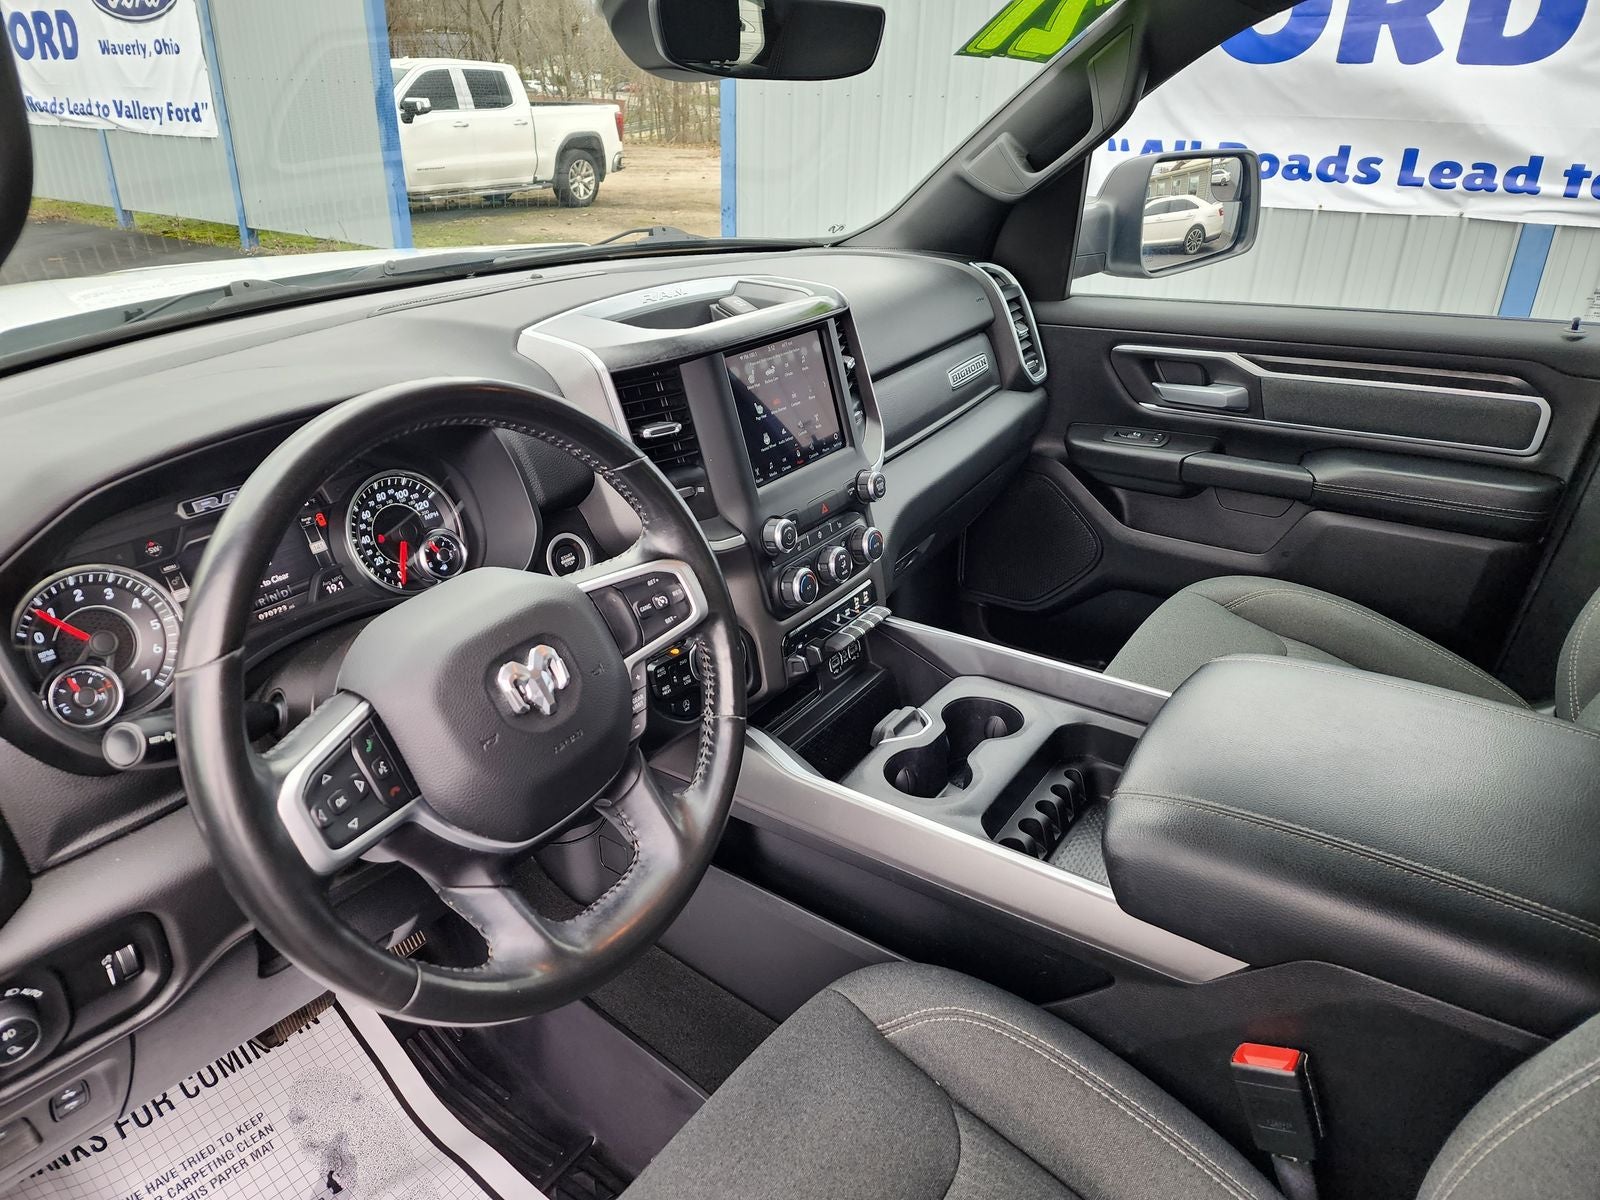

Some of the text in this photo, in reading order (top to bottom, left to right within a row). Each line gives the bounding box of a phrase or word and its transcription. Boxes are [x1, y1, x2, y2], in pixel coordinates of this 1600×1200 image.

[98, 39, 180, 59] Waverly, Ohio
[67, 97, 94, 116] Lead
[97, 100, 110, 118] to
[113, 99, 163, 125] Vallery
[1219, 141, 1600, 200] oads Lead t
[951, 358, 987, 382] BIGHORN
[376, 491, 387, 502] 80
[395, 489, 409, 500] 100
[414, 500, 430, 511] 120
[361, 510, 371, 520] 60
[361, 535, 371, 545] 40
[149, 546, 160, 554] SW
[374, 556, 384, 566] 20
[326, 581, 344, 594] 19.1
[73, 589, 84, 602] 2
[103, 588, 114, 600] 3
[132, 598, 142, 609] 4
[150, 619, 160, 630] 5
[33, 631, 45, 644] 0
[152, 644, 163, 655] 6
[141, 669, 152, 681] 7
[20, 988, 43, 998] AUTO
[145, 1168, 179, 1194] HAVE
[179, 1144, 216, 1172] TRIED
[217, 1132, 235, 1147] TO
[236, 1112, 264, 1136] KEEP
[167, 1123, 275, 1199] CARPETING CLEAN
[209, 1158, 249, 1189] PAPER
[250, 1140, 276, 1163] MAT
